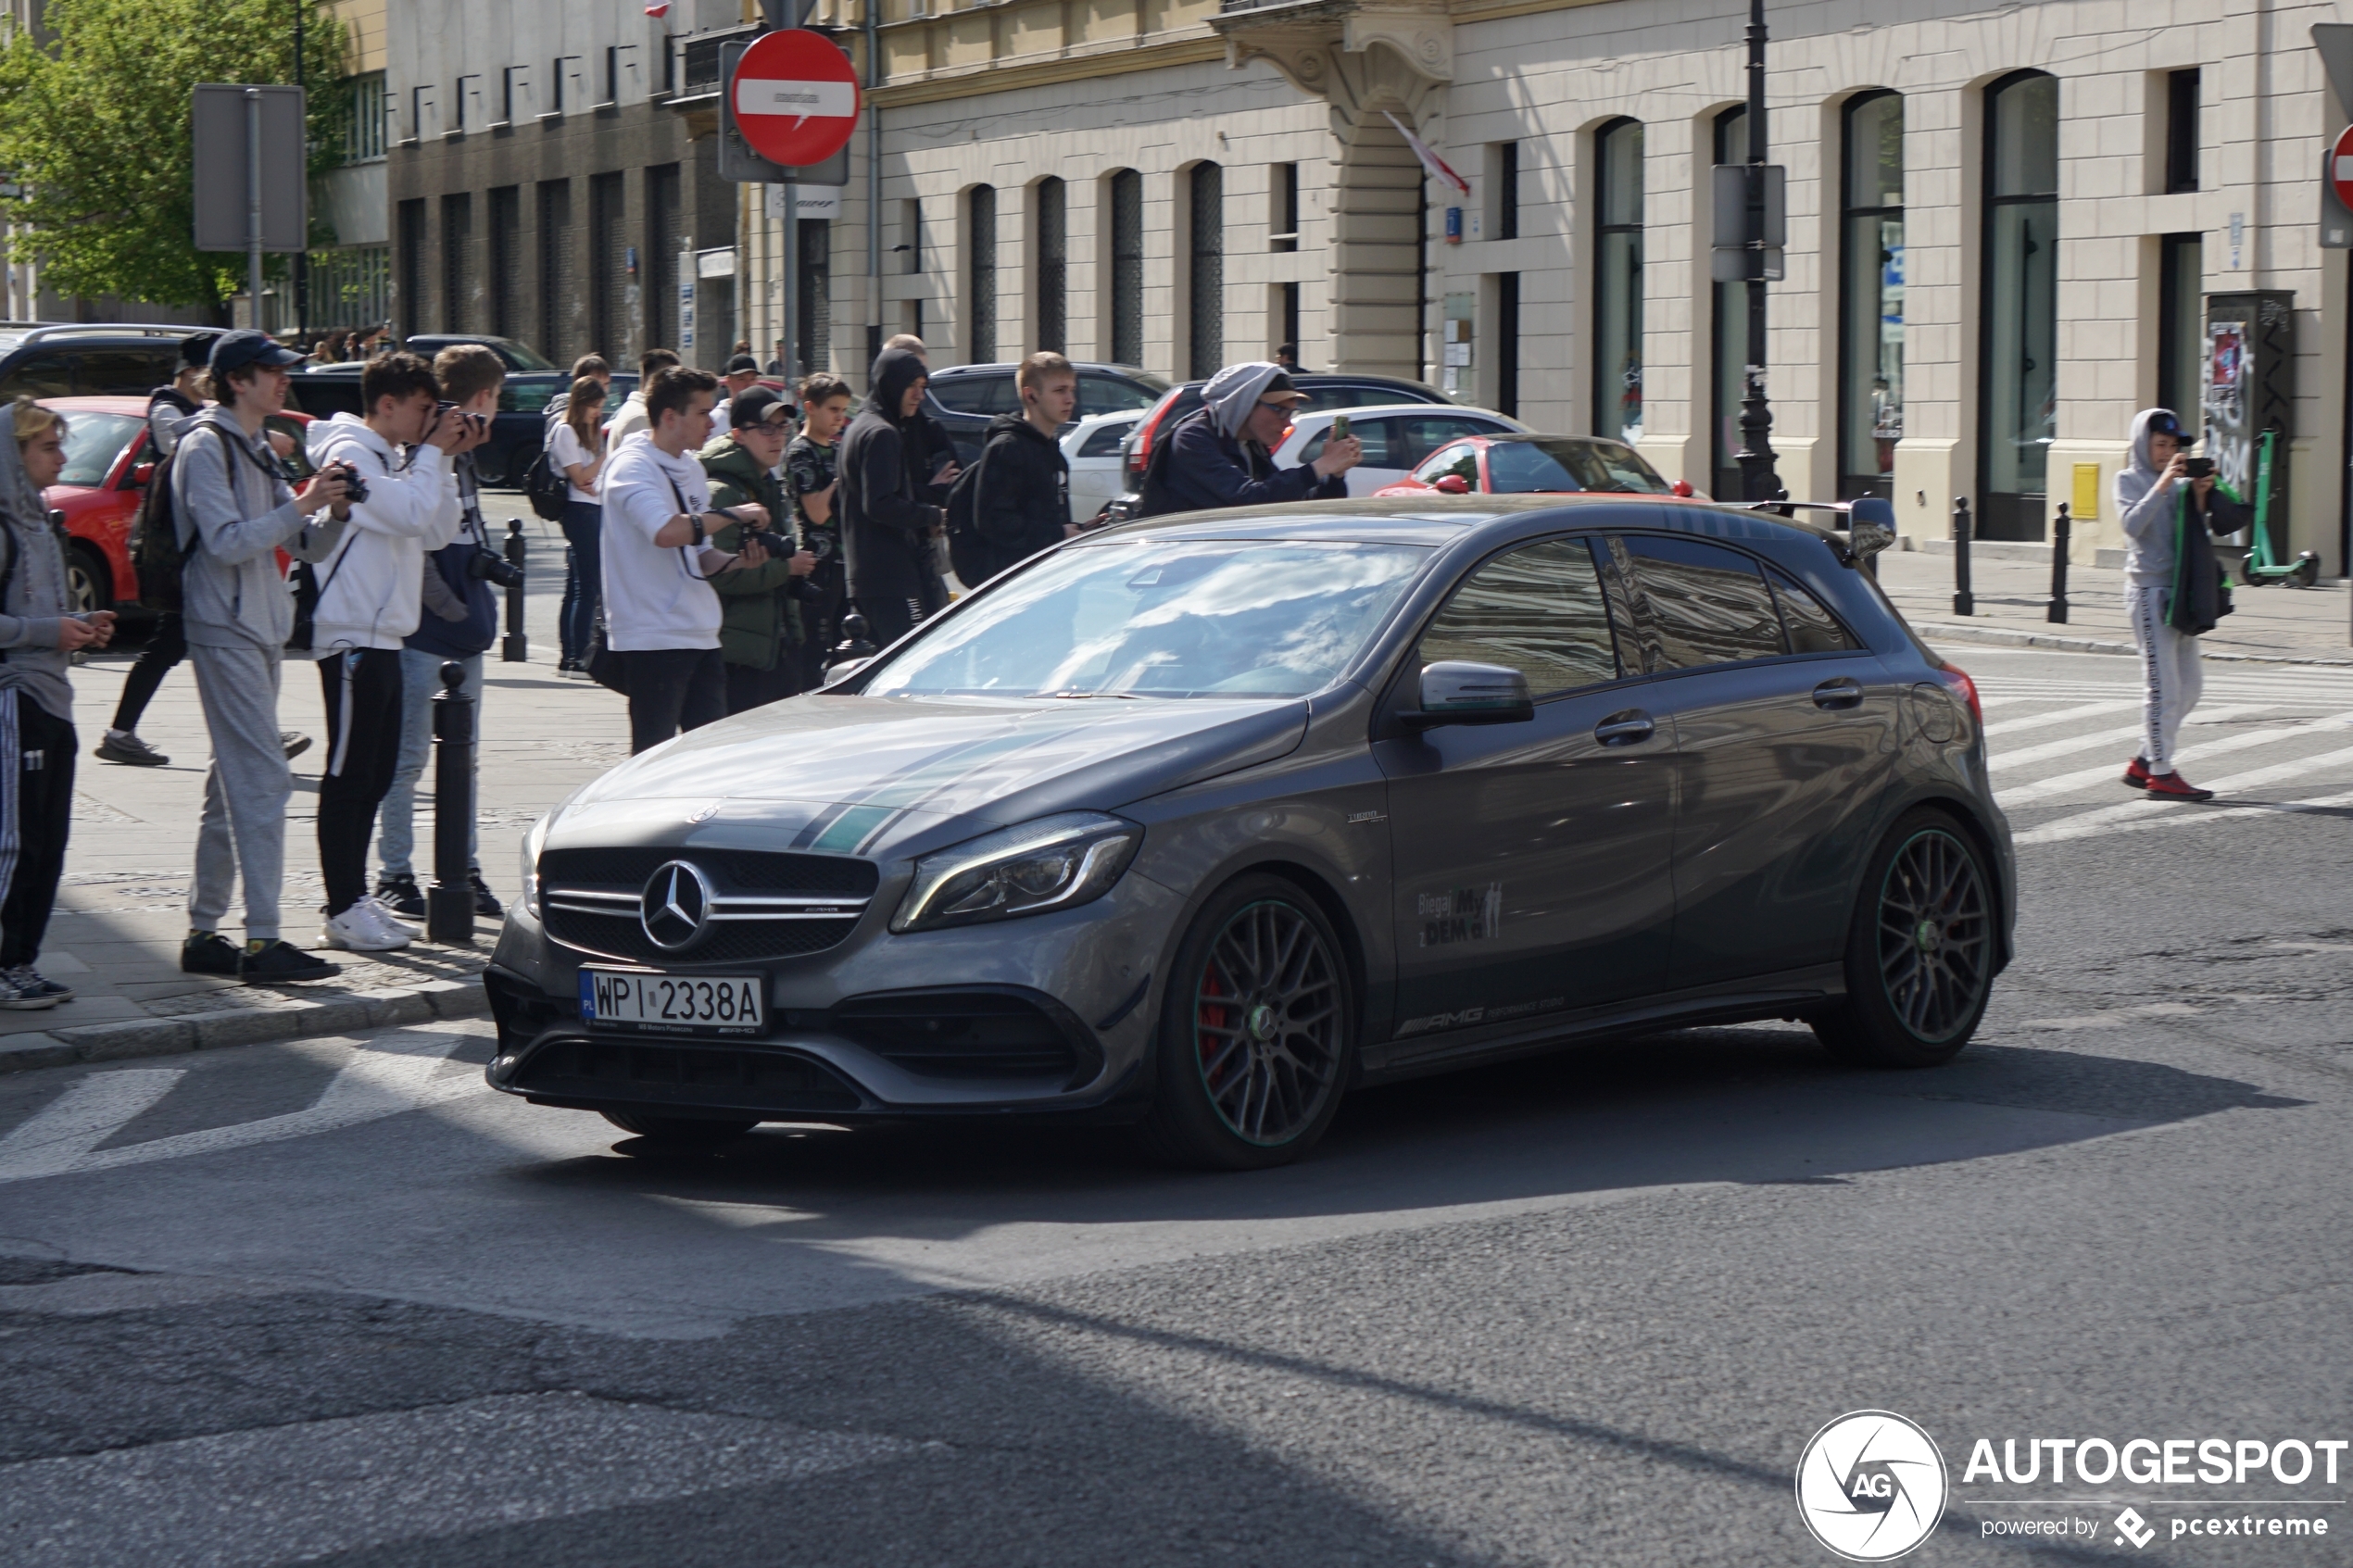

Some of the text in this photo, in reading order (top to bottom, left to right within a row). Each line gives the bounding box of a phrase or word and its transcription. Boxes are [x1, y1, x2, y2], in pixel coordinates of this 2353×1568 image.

[1418, 890, 1453, 919] Biegaj
[583, 999, 594, 1010] PL
[595, 976, 758, 1022] WPI 2338A
[1423, 996, 1565, 1030] AMG PERFORMANCE STUDIO
